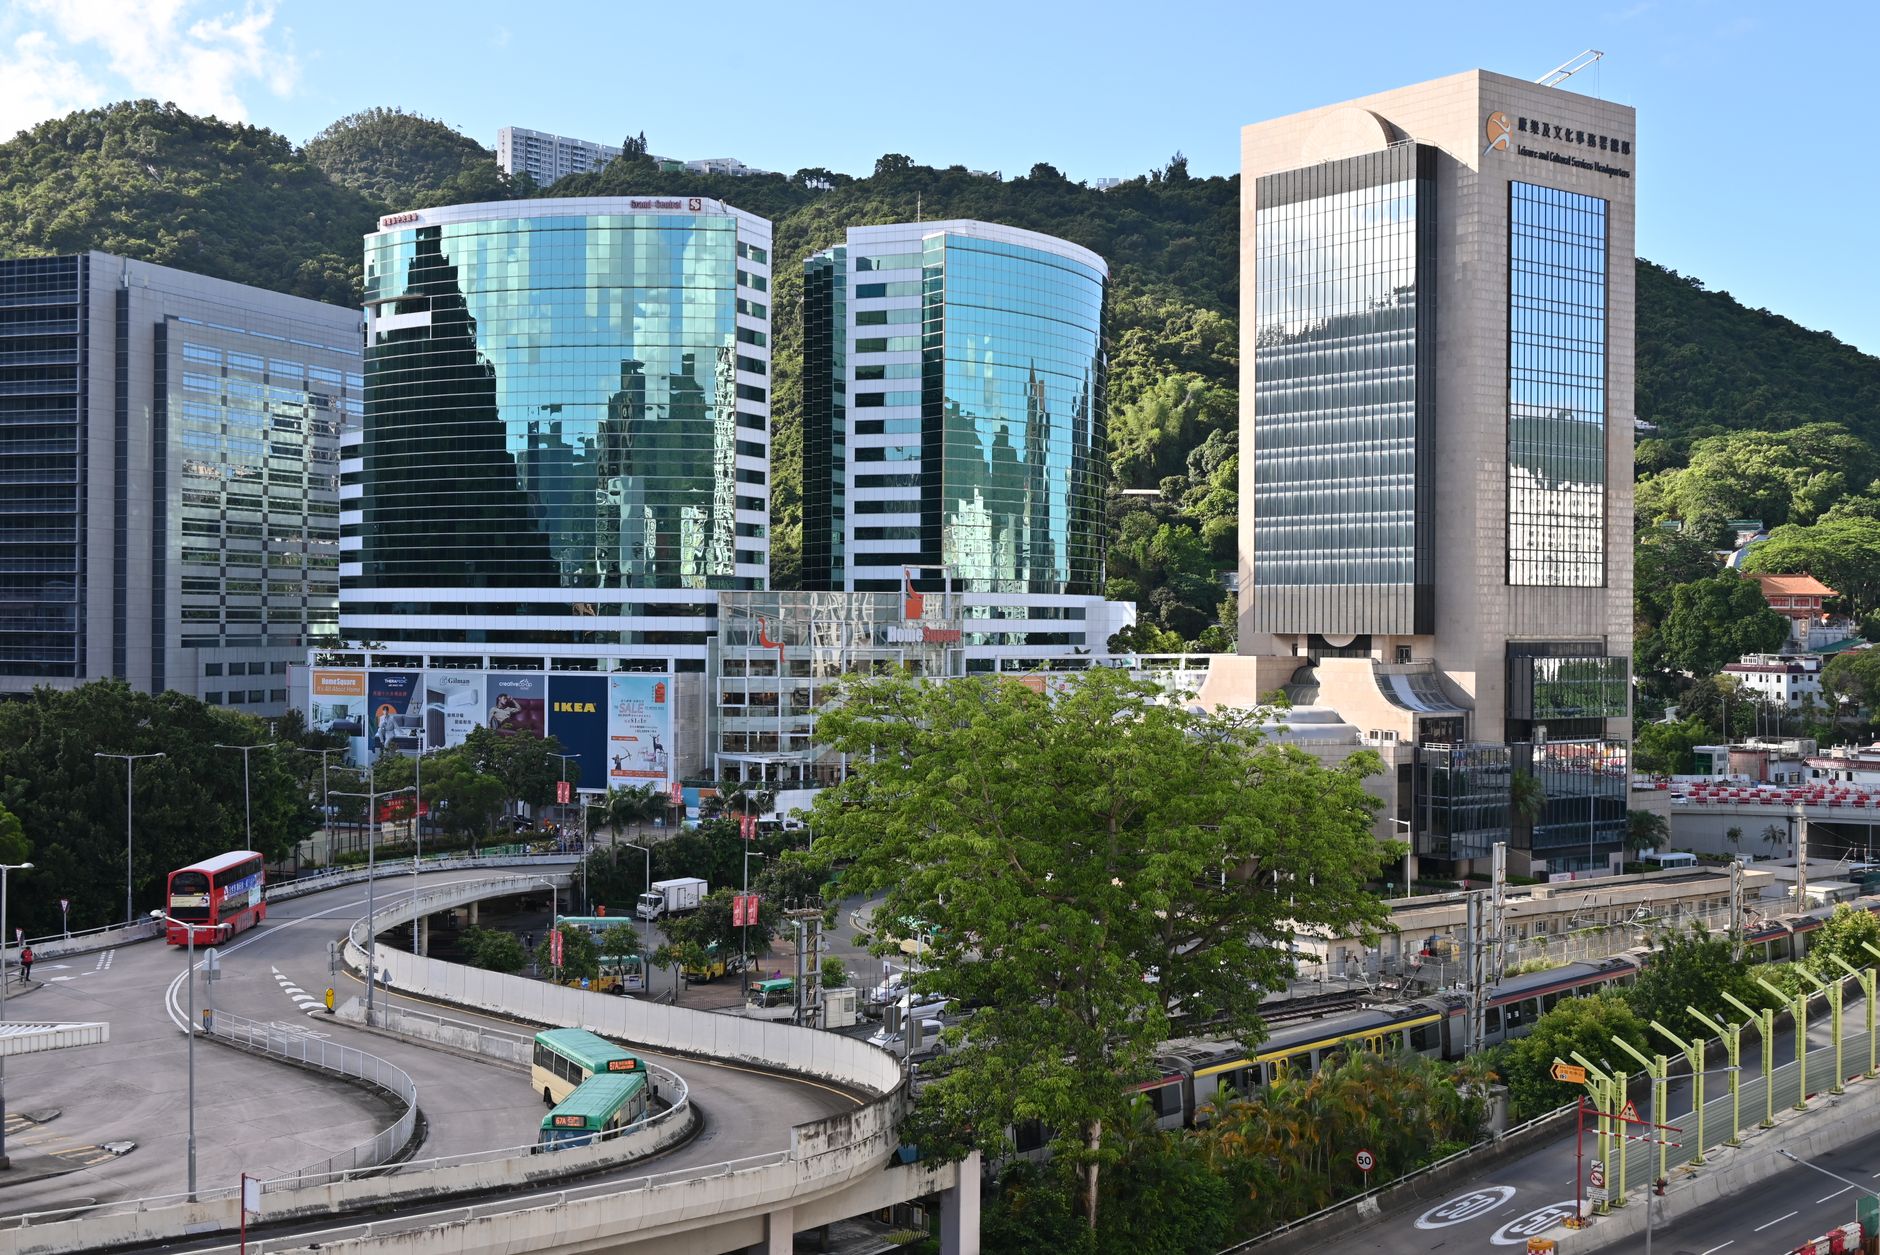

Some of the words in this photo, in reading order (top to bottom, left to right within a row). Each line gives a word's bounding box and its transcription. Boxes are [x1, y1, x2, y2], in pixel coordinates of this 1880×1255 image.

[1518, 117, 1630, 155] 康樂及文化事務署總部
[1517, 145, 1538, 158] Leisure
[1538, 151, 1549, 161] and
[1549, 152, 1571, 166] Cultural
[1571, 156, 1594, 171] Services
[1594, 161, 1630, 178] Headquarters
[887, 625, 961, 643] HomeSquare
[321, 678, 356, 686] HomeSquare
[554, 702, 596, 713] IKEA
[619, 703, 644, 714] SALE
[1357, 1156, 1372, 1165] 50
[1435, 1194, 1497, 1220] 50
